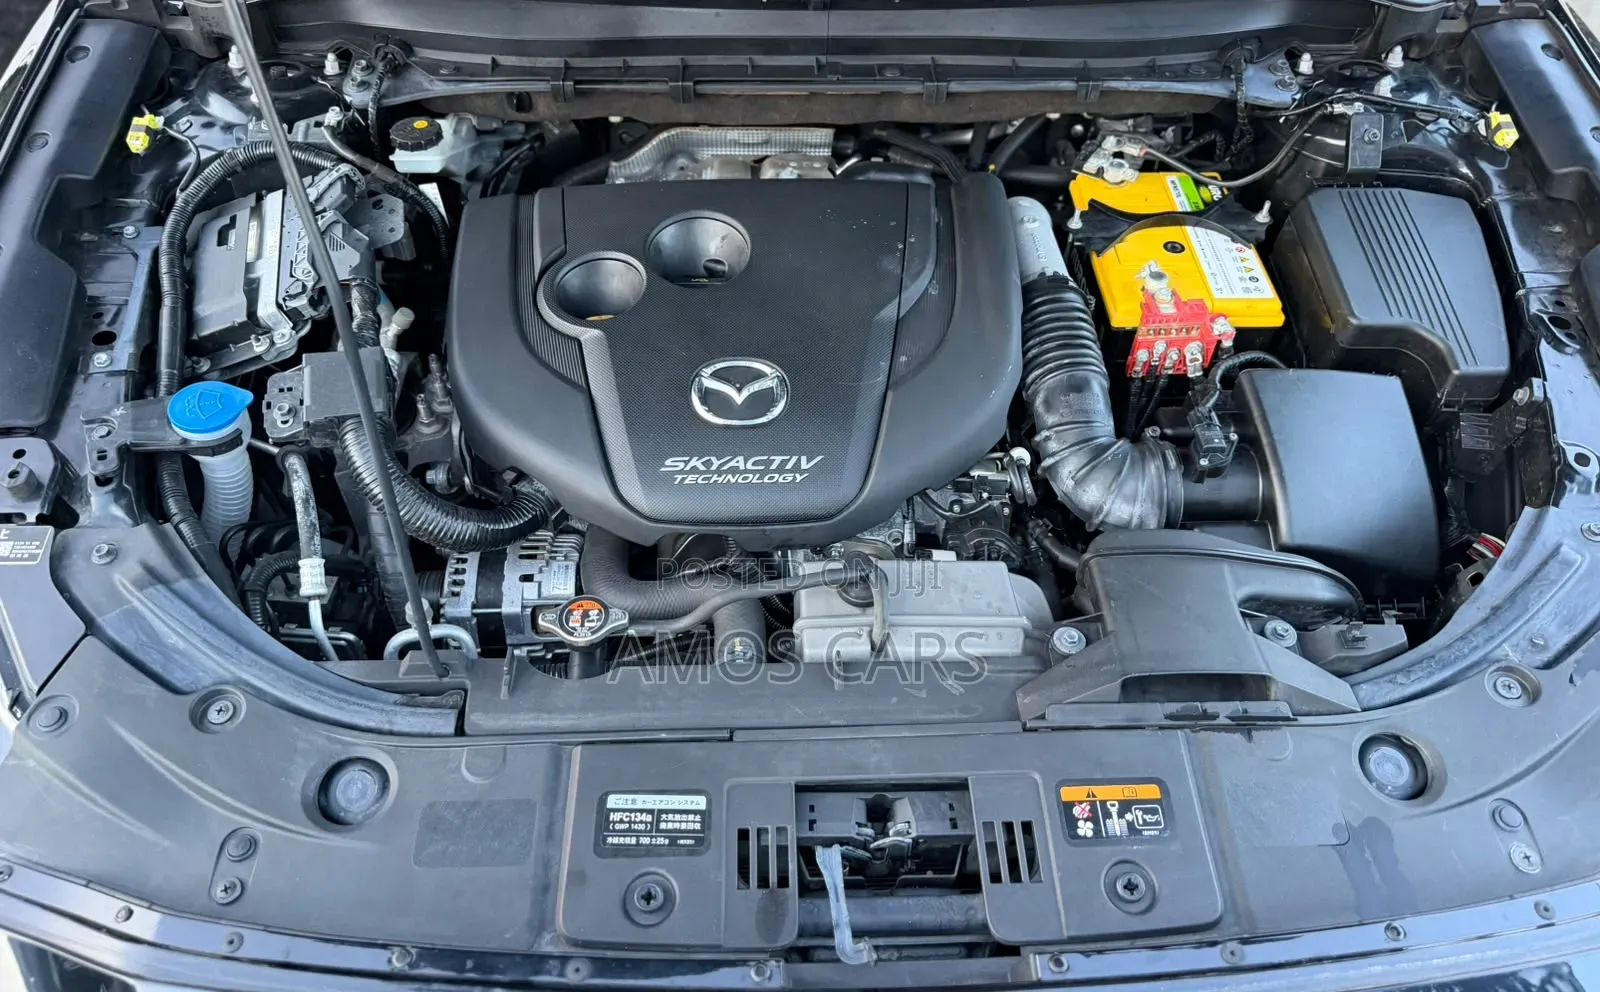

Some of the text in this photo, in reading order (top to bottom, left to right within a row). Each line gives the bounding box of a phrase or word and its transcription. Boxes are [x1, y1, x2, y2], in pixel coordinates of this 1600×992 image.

[659, 455, 825, 472] SKYACTIV
[673, 473, 810, 485] TECHNOLOGY
[609, 811, 653, 822] HFC134a
